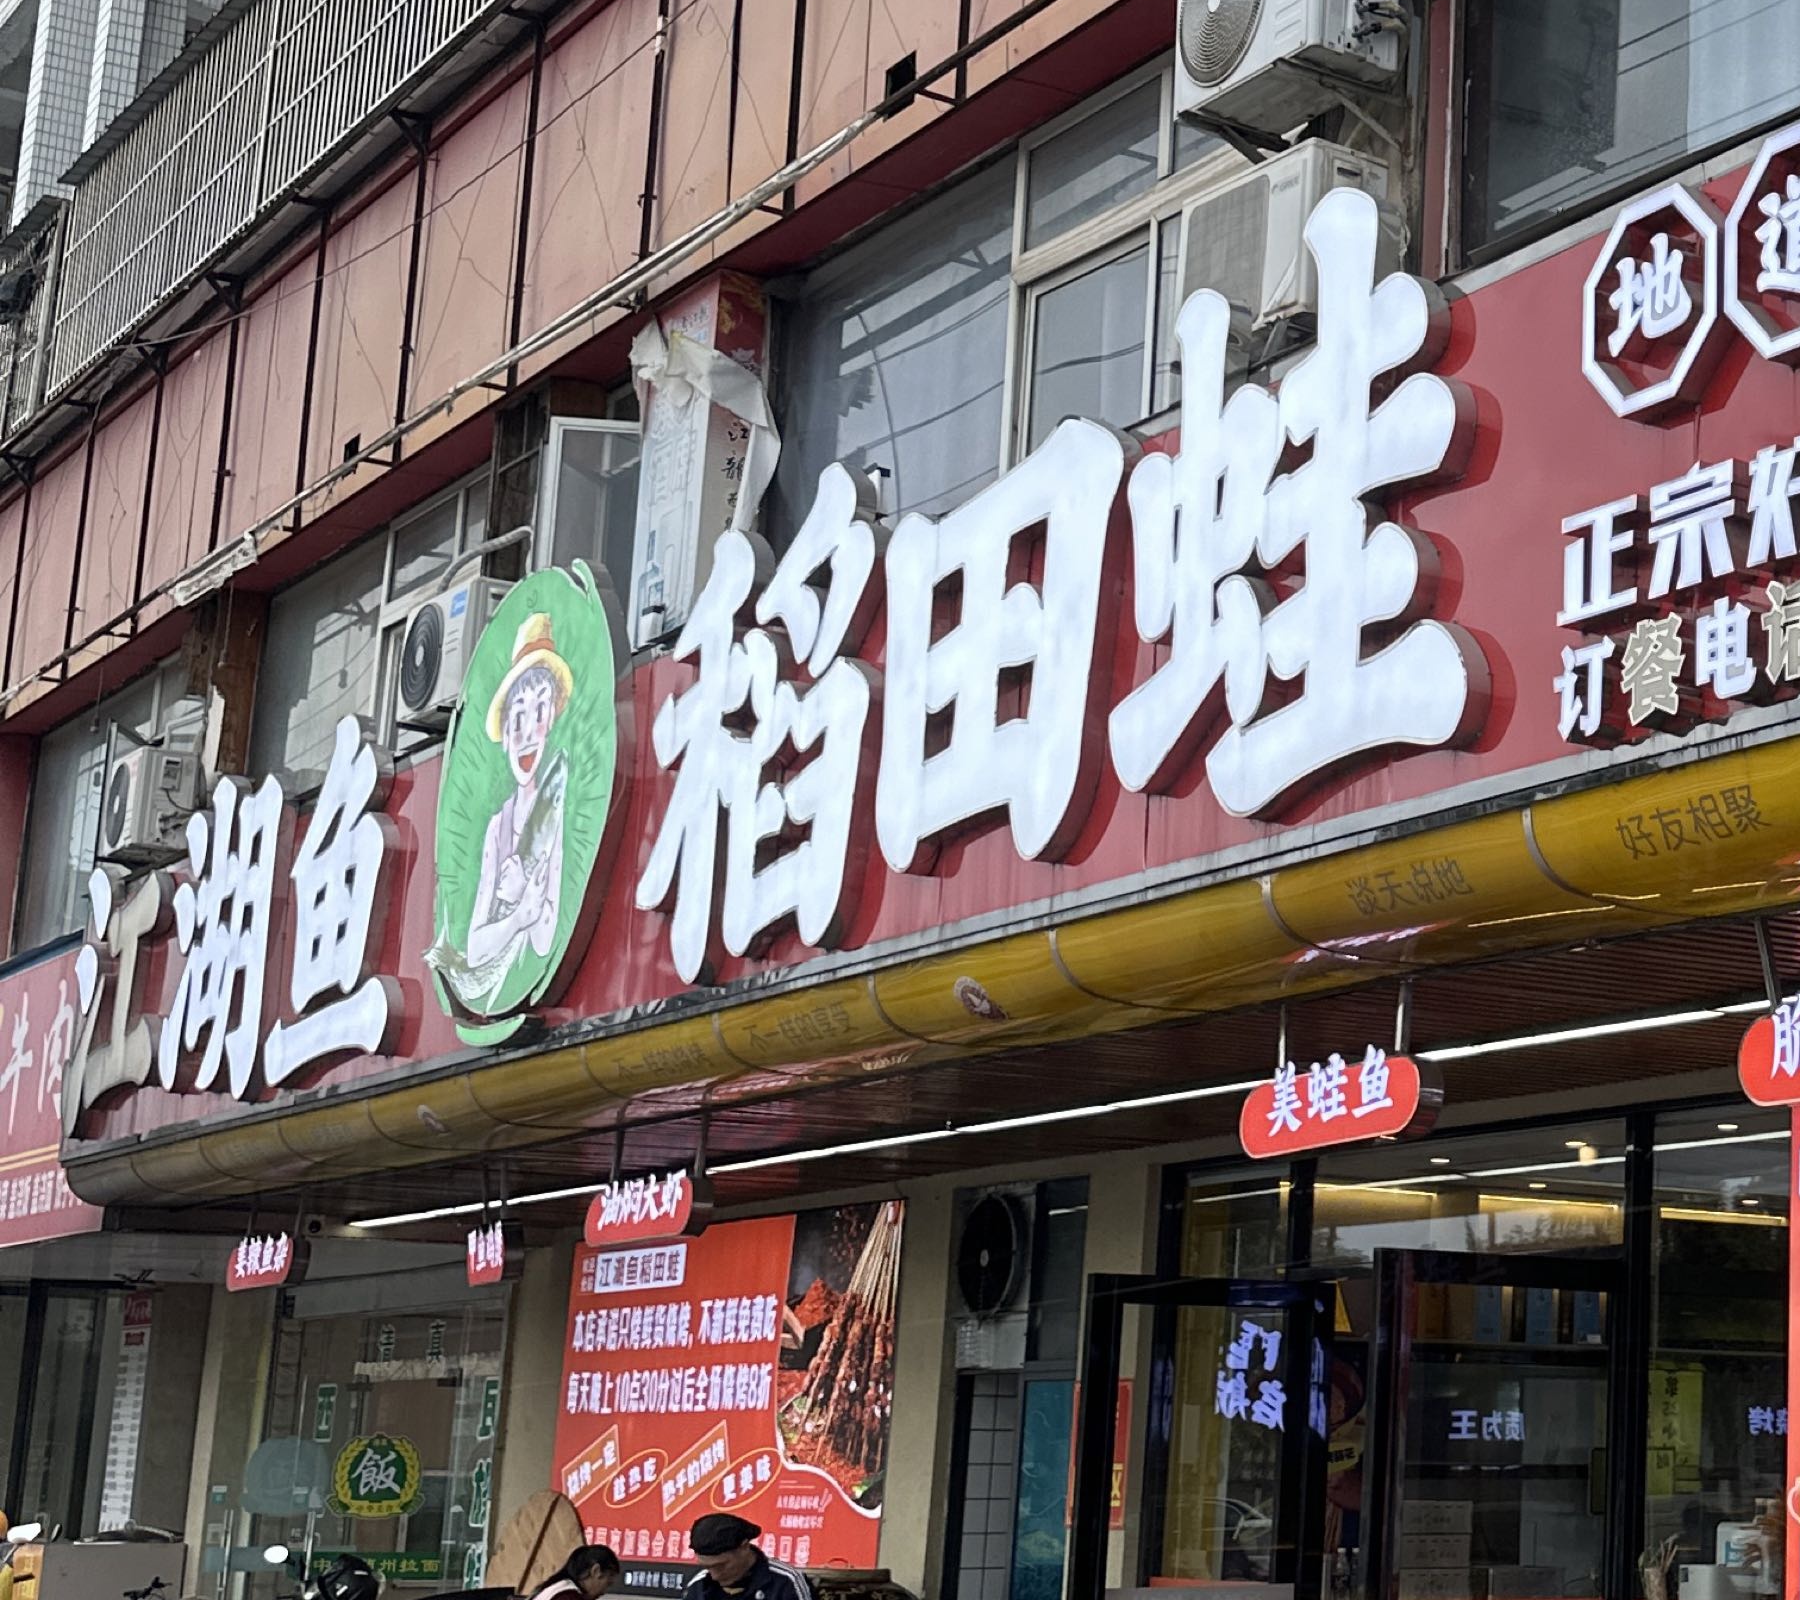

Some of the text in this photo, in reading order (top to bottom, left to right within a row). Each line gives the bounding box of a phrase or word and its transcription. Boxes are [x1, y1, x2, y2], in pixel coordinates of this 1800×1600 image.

[63, 185, 1470, 1140] 江湖鱼 稻田蛙
[1615, 787, 1771, 860] 好友相聚
[1347, 858, 1477, 916] 谈天说地
[1267, 1045, 1392, 1137] 美蛙鱼
[597, 1169, 687, 1230] 油焖大虾
[600, 1249, 680, 1287] 江湖鱼稻田蛙
[313, 1558, 440, 1573] 中州拉面
